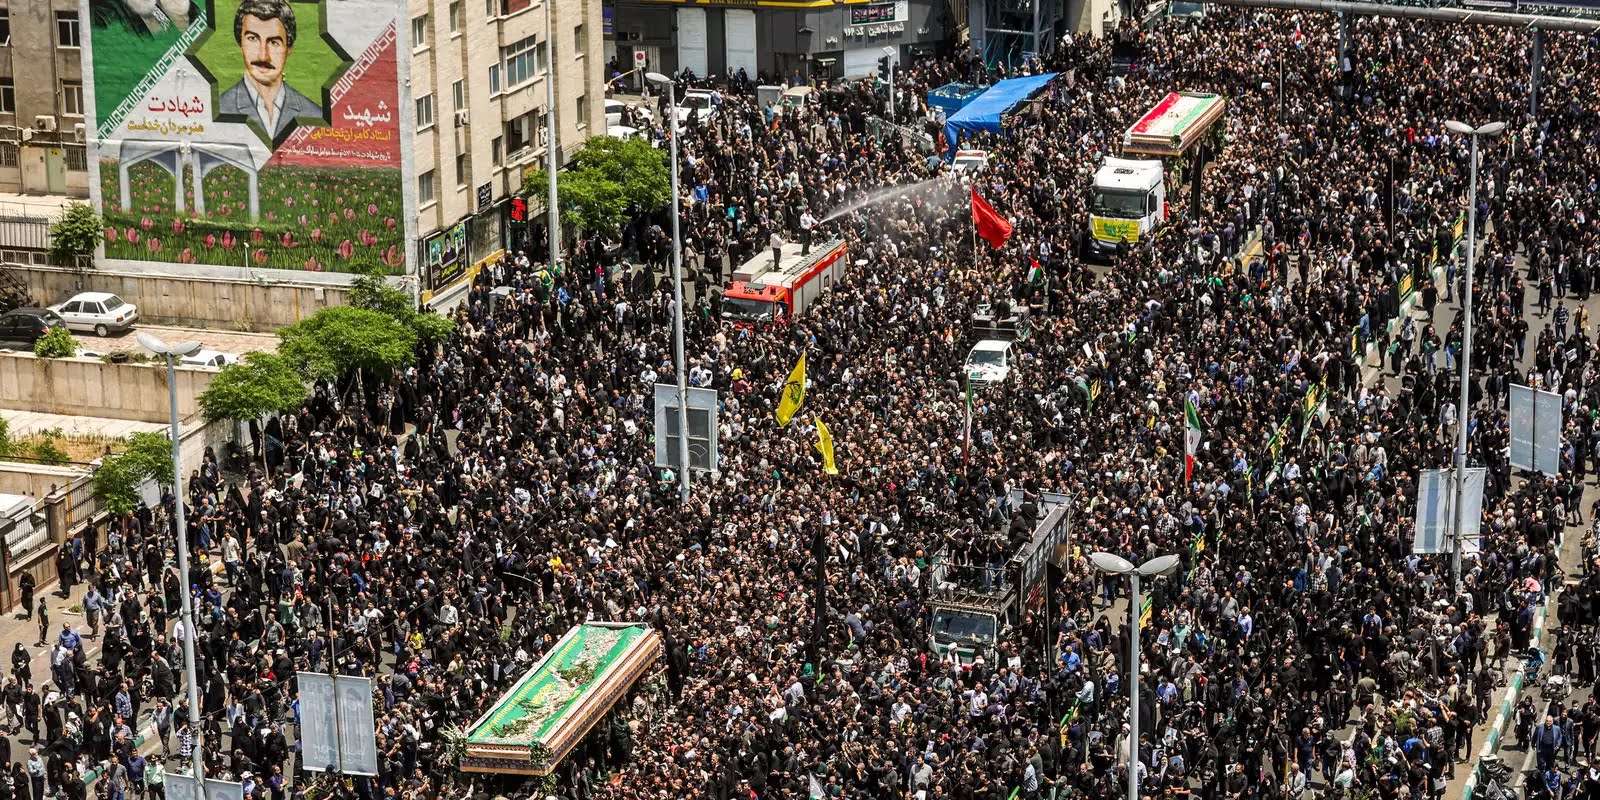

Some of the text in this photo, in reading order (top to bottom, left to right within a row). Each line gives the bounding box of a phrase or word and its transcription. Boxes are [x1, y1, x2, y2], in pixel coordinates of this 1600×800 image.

[148, 95, 204, 118] شهادت
[343, 100, 391, 127] شهید
[160, 117, 188, 135] مردان
[188, 121, 204, 135] هنر
[344, 127, 370, 142] کامران
[370, 130, 391, 141] استاد
